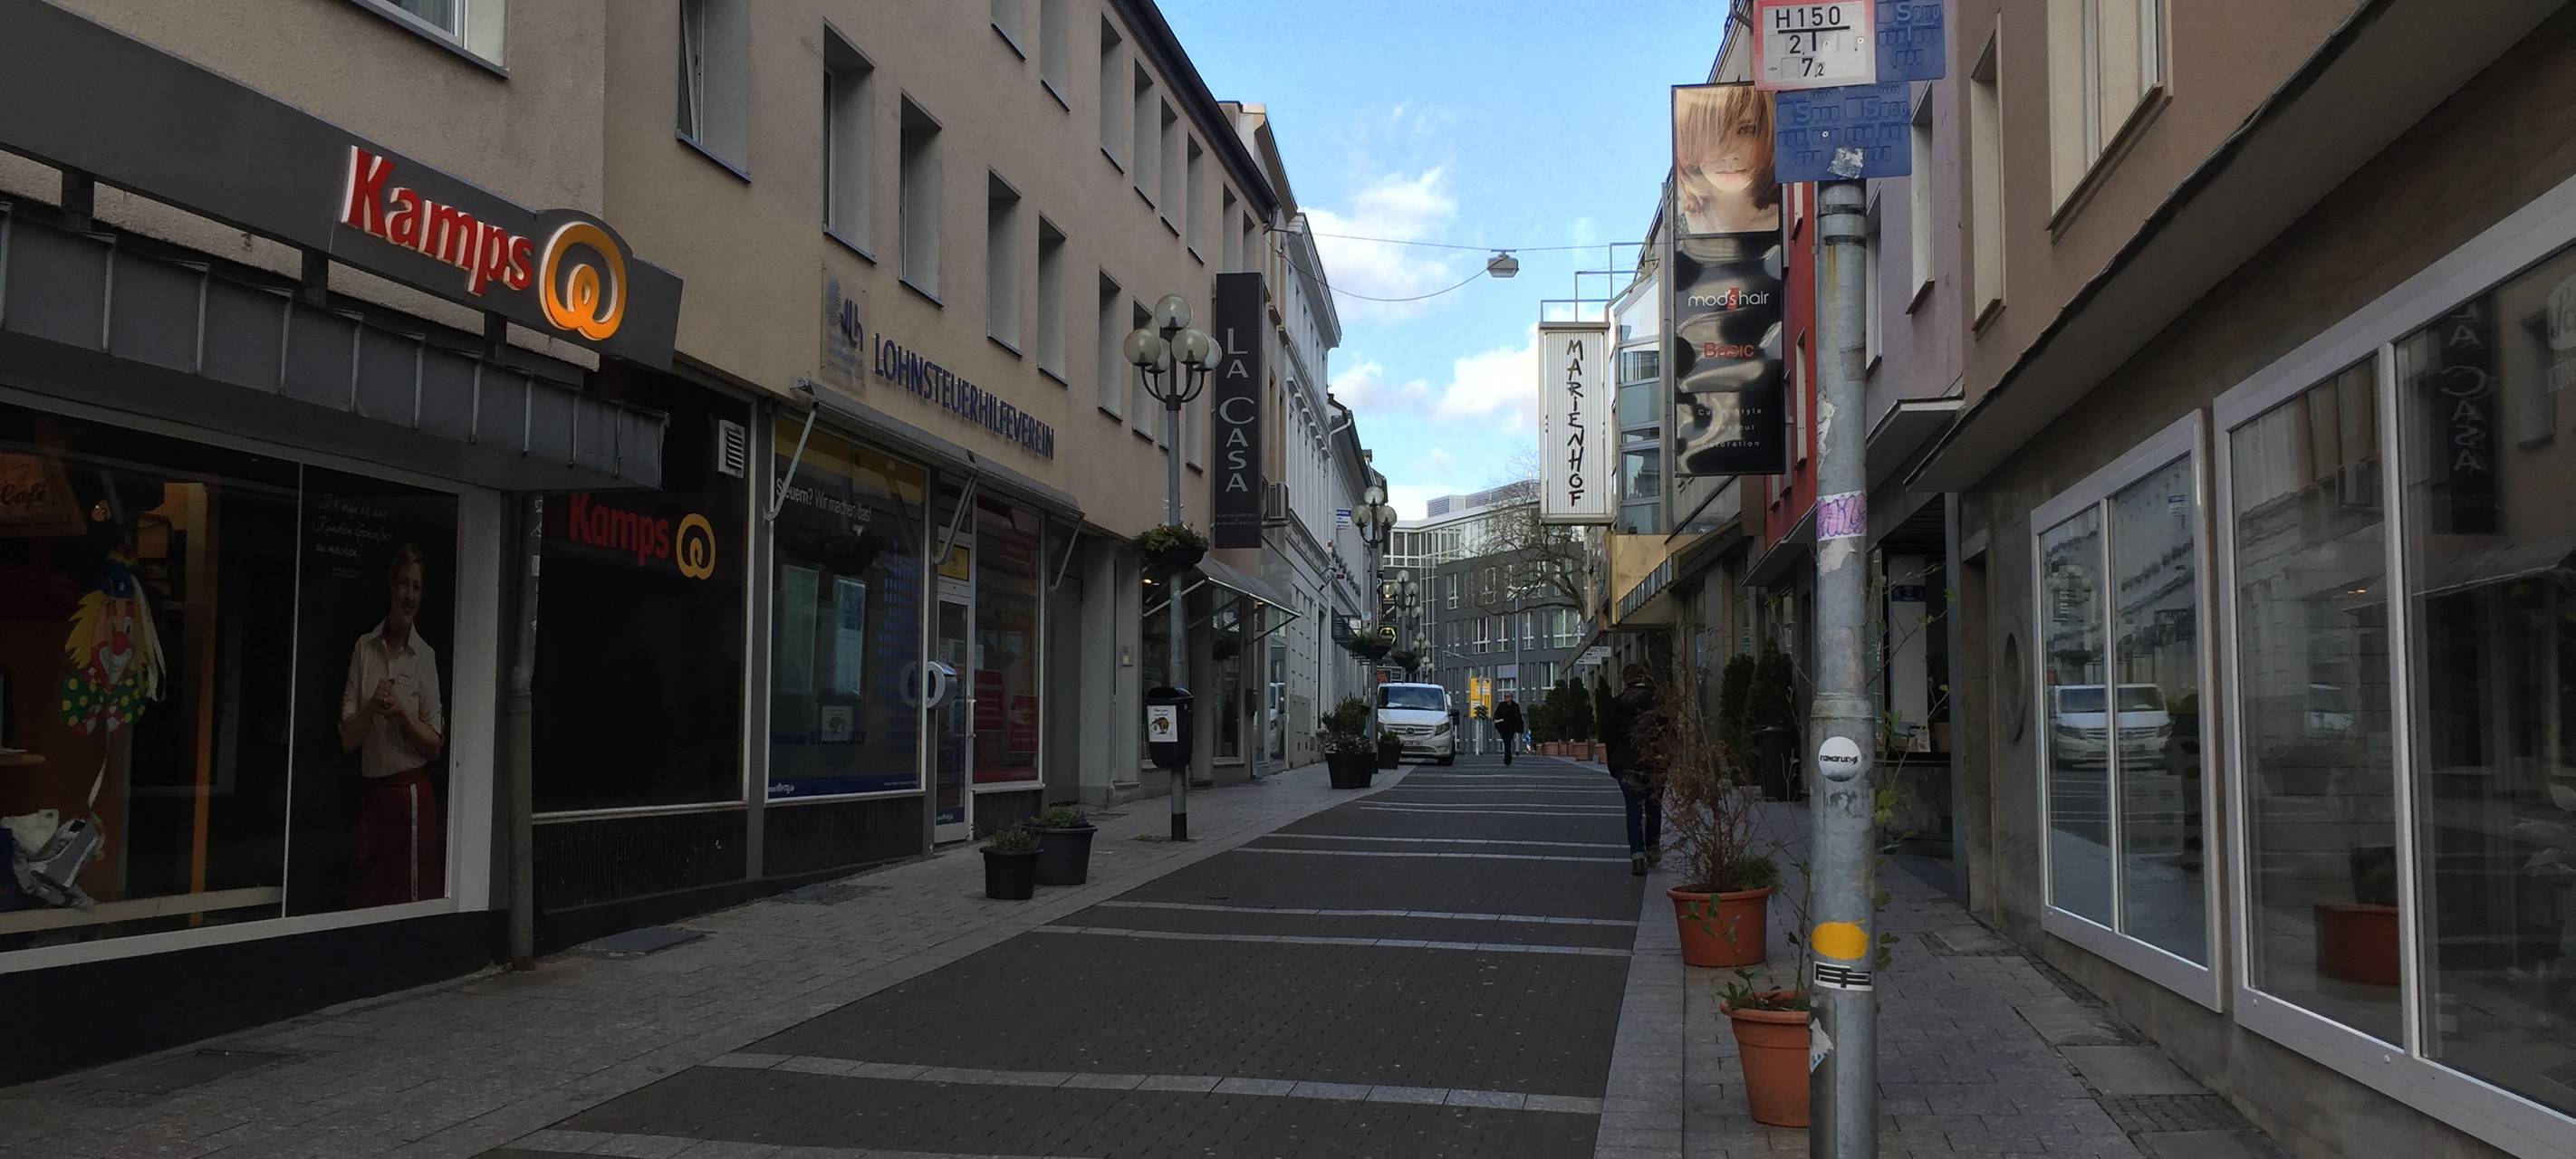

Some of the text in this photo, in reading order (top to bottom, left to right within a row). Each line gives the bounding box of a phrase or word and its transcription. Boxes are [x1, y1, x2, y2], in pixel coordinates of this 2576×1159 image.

[1776, 6, 1841, 29] H150
[341, 145, 535, 296] Kamps
[1739, 290, 1770, 305] hair
[872, 331, 1055, 459] LOHNSTEUERHILFEVEREIN
[1219, 397, 1256, 493] CASA
[568, 493, 671, 567] Kamps
